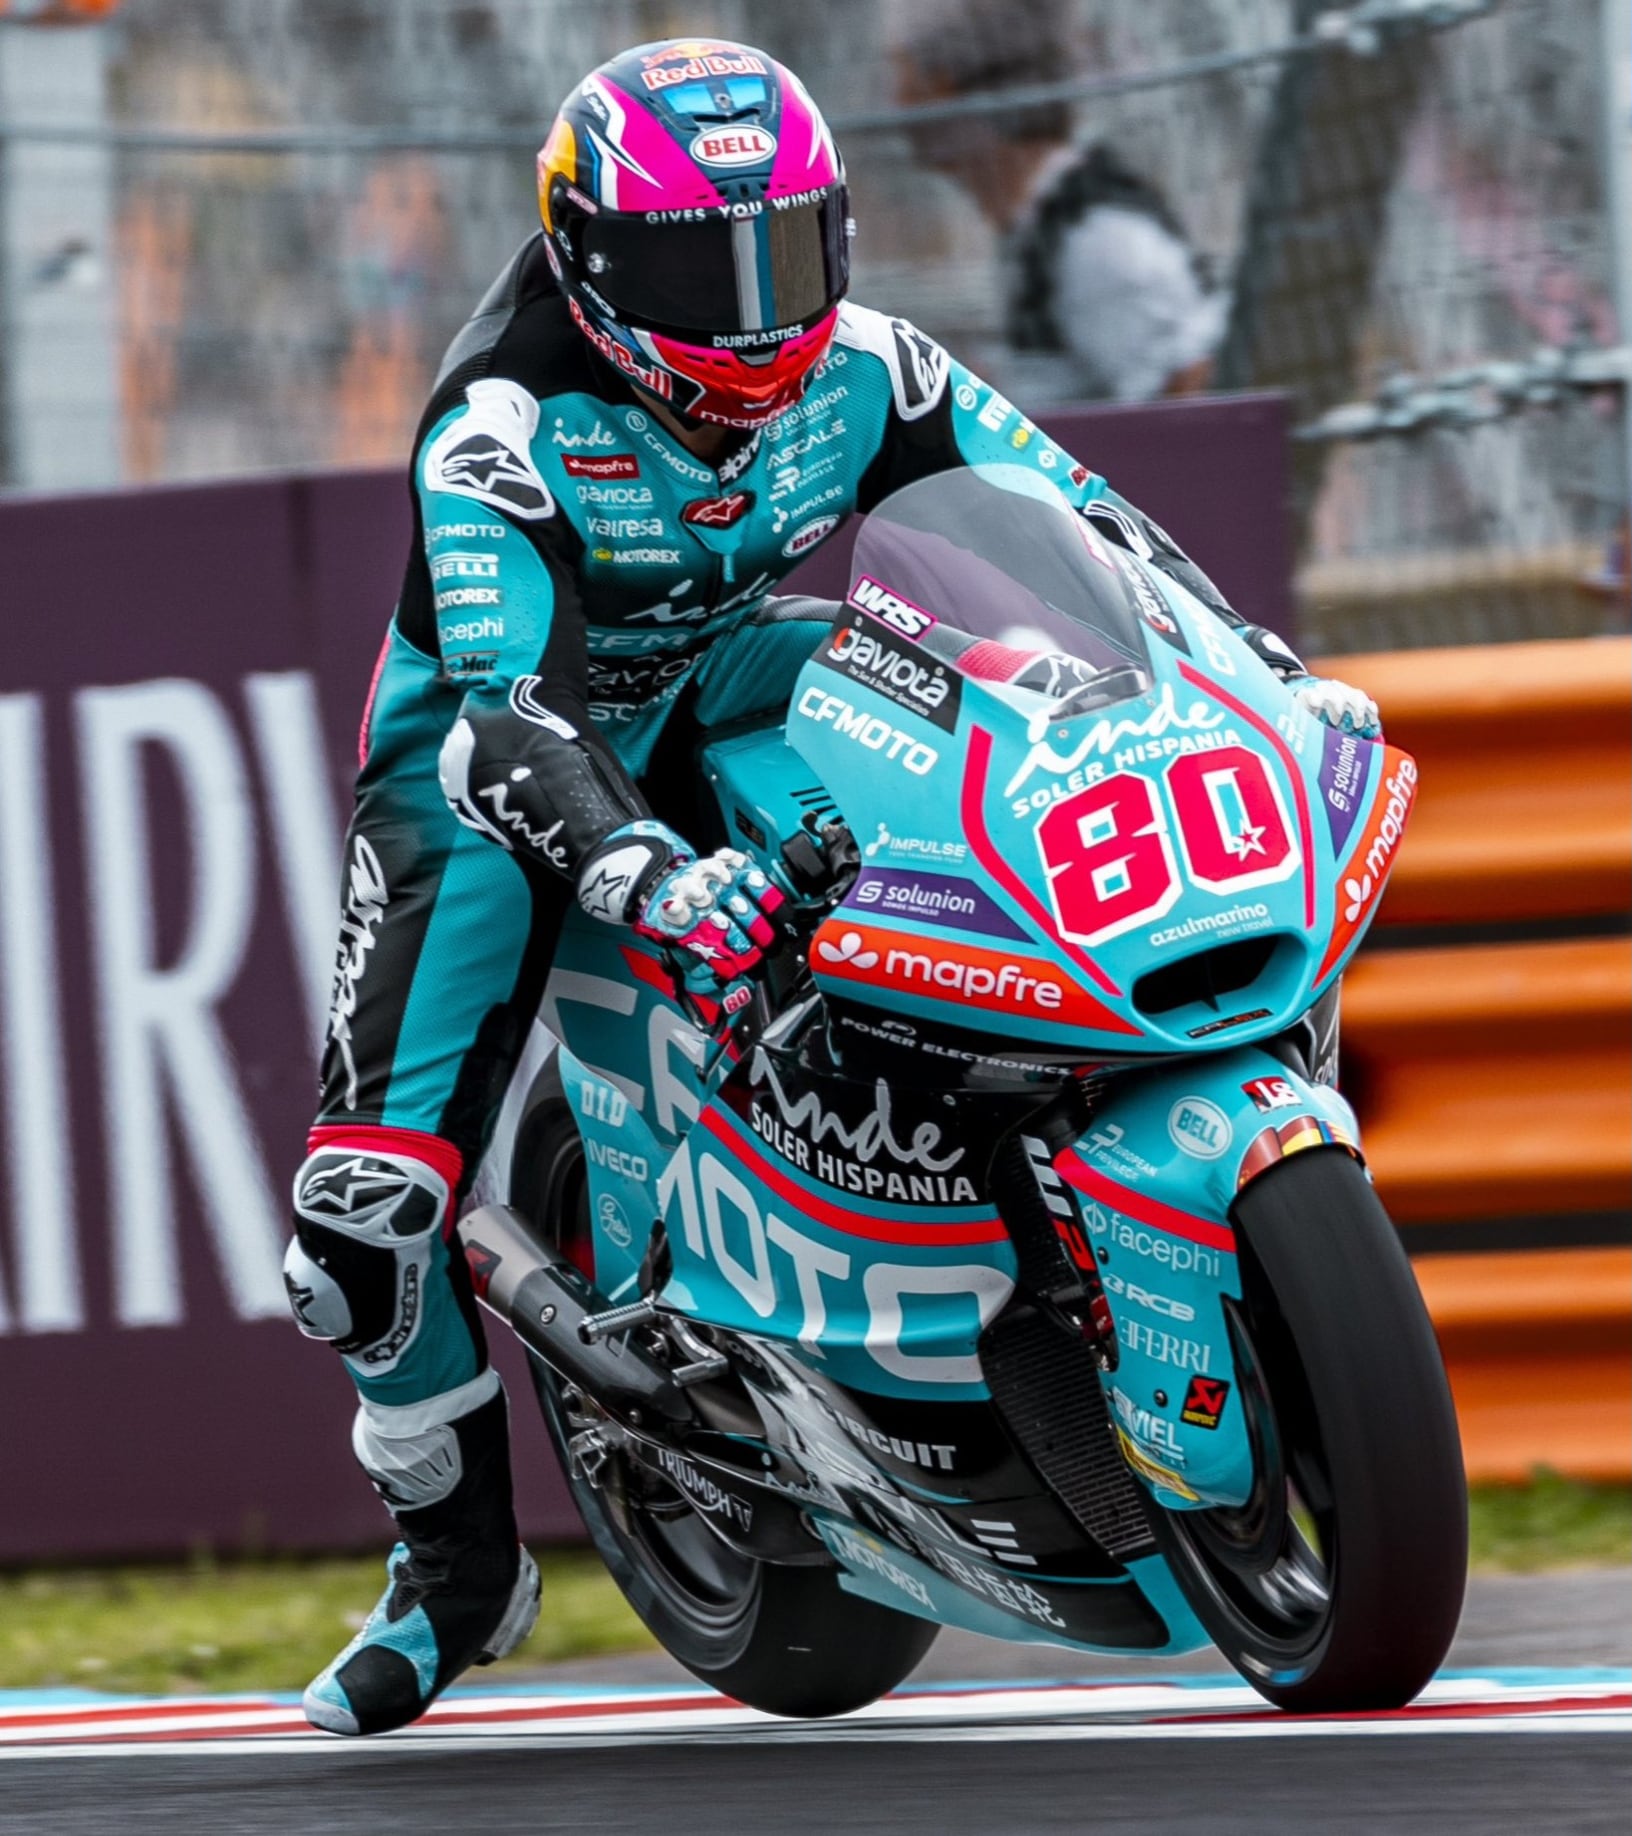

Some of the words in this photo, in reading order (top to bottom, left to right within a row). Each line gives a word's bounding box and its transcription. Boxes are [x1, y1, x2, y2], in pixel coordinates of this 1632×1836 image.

[640, 60, 705, 91] Red
[706, 54, 768, 77] Bull
[703, 135, 767, 158] BELL
[645, 209, 705, 224] GIVES
[718, 199, 764, 217] YOU
[771, 186, 828, 209] WINGS
[712, 324, 804, 348] DURPLASTICS
[612, 338, 672, 401] Bull
[552, 417, 617, 448] inde
[643, 432, 713, 483] CFMOTO
[718, 427, 762, 482] alpin
[613, 549, 681, 564] MOTOREX
[791, 522, 831, 550] BELL
[852, 578, 932, 636] WRS
[826, 627, 950, 709] gaviota
[797, 686, 939, 776] CFMOTO
[1003, 682, 1226, 798] inde
[1011, 761, 1105, 819] SOLER
[1113, 729, 1242, 770] HISPANIA
[1333, 736, 1358, 794] solunion
[477, 766, 569, 868] inde
[1366, 758, 1418, 879] mapfre
[889, 837, 967, 858] IMPULSE
[1032, 745, 1303, 948] 80
[885, 883, 976, 915] solunion
[1150, 903, 1269, 947] azulmarino
[1216, 927, 1243, 939] new
[885, 948, 1063, 1008] mapfre
[841, 1016, 916, 1049] POWER
[921, 1042, 1072, 1076] ELECTRONICS
[750, 1101, 810, 1171] SOLER
[817, 1152, 979, 1202] HISPANIA
[1176, 1107, 1218, 1149] BELL
[587, 1138, 649, 1183] IVECO
[1110, 1211, 1221, 1278] facephi
[657, 1449, 733, 1518] TRIUMPH
